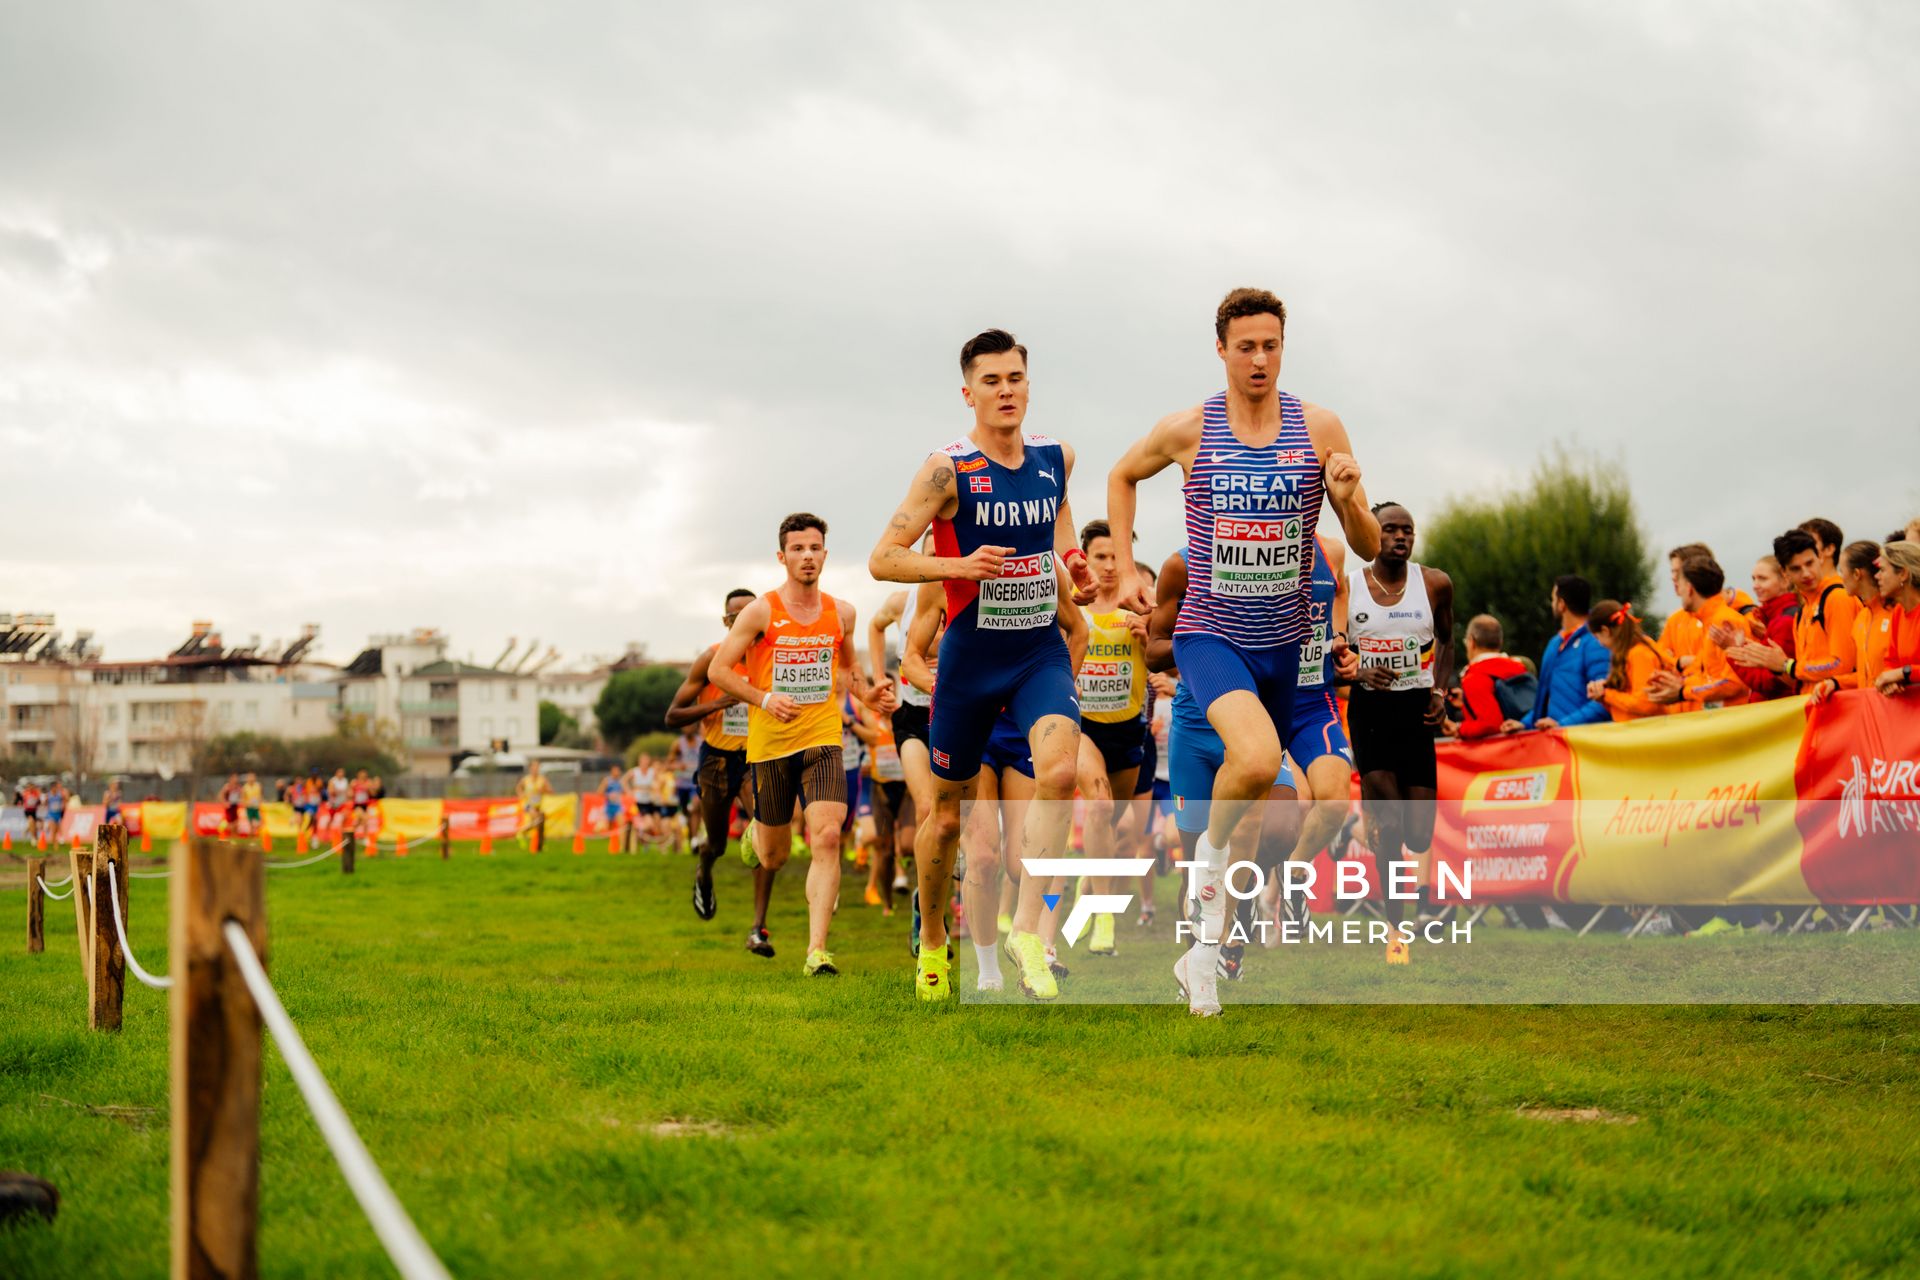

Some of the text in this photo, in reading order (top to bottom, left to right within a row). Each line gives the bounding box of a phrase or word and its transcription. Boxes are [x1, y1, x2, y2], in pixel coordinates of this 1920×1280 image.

[1211, 474, 1303, 492] GREAT
[1212, 494, 1303, 511] BRITAIN
[976, 496, 1057, 527] NORWAY
[1217, 521, 1281, 539] SPAR
[1216, 544, 1299, 566] MILNER
[1001, 559, 1039, 575] PAR
[982, 578, 1056, 601] INGEBRIGTSEN
[1217, 580, 1296, 593] ANTALYA 2024
[982, 617, 1032, 627] ANTALYA
[1388, 610, 1413, 619] Allianz
[774, 634, 835, 645] ESPAÑA
[1359, 639, 1402, 651] SPAR
[775, 651, 818, 663] SPAR
[1361, 653, 1418, 669] KIMELI
[775, 667, 830, 683] LAS HERAS
[1300, 674, 1320, 684] 2024
[1604, 780, 1760, 848] Antalya 2024
[1466, 822, 1550, 849] CROSS COUNTRY
